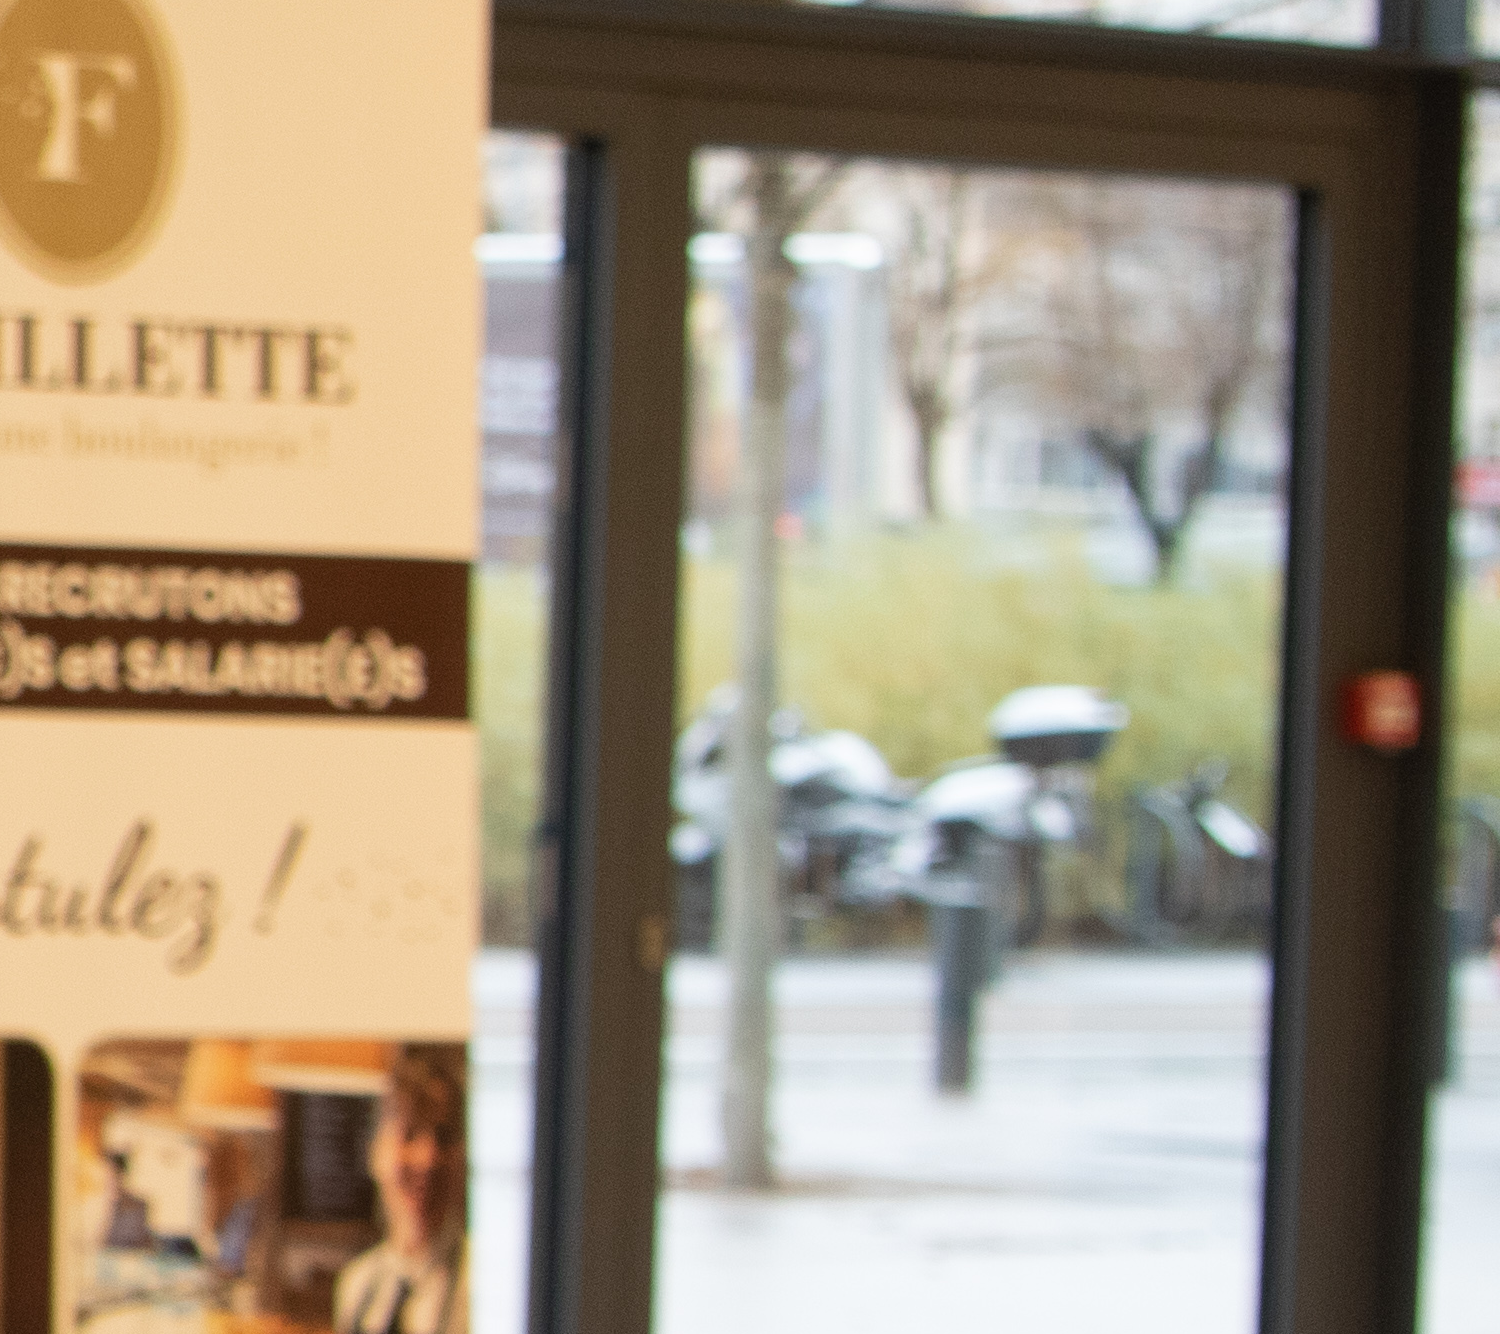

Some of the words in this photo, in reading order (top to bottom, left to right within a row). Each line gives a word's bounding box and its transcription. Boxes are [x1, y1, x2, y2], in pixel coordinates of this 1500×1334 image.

[20, 51, 138, 185] F
[58, 637, 119, 694] et
[252, 817, 310, 935] !
